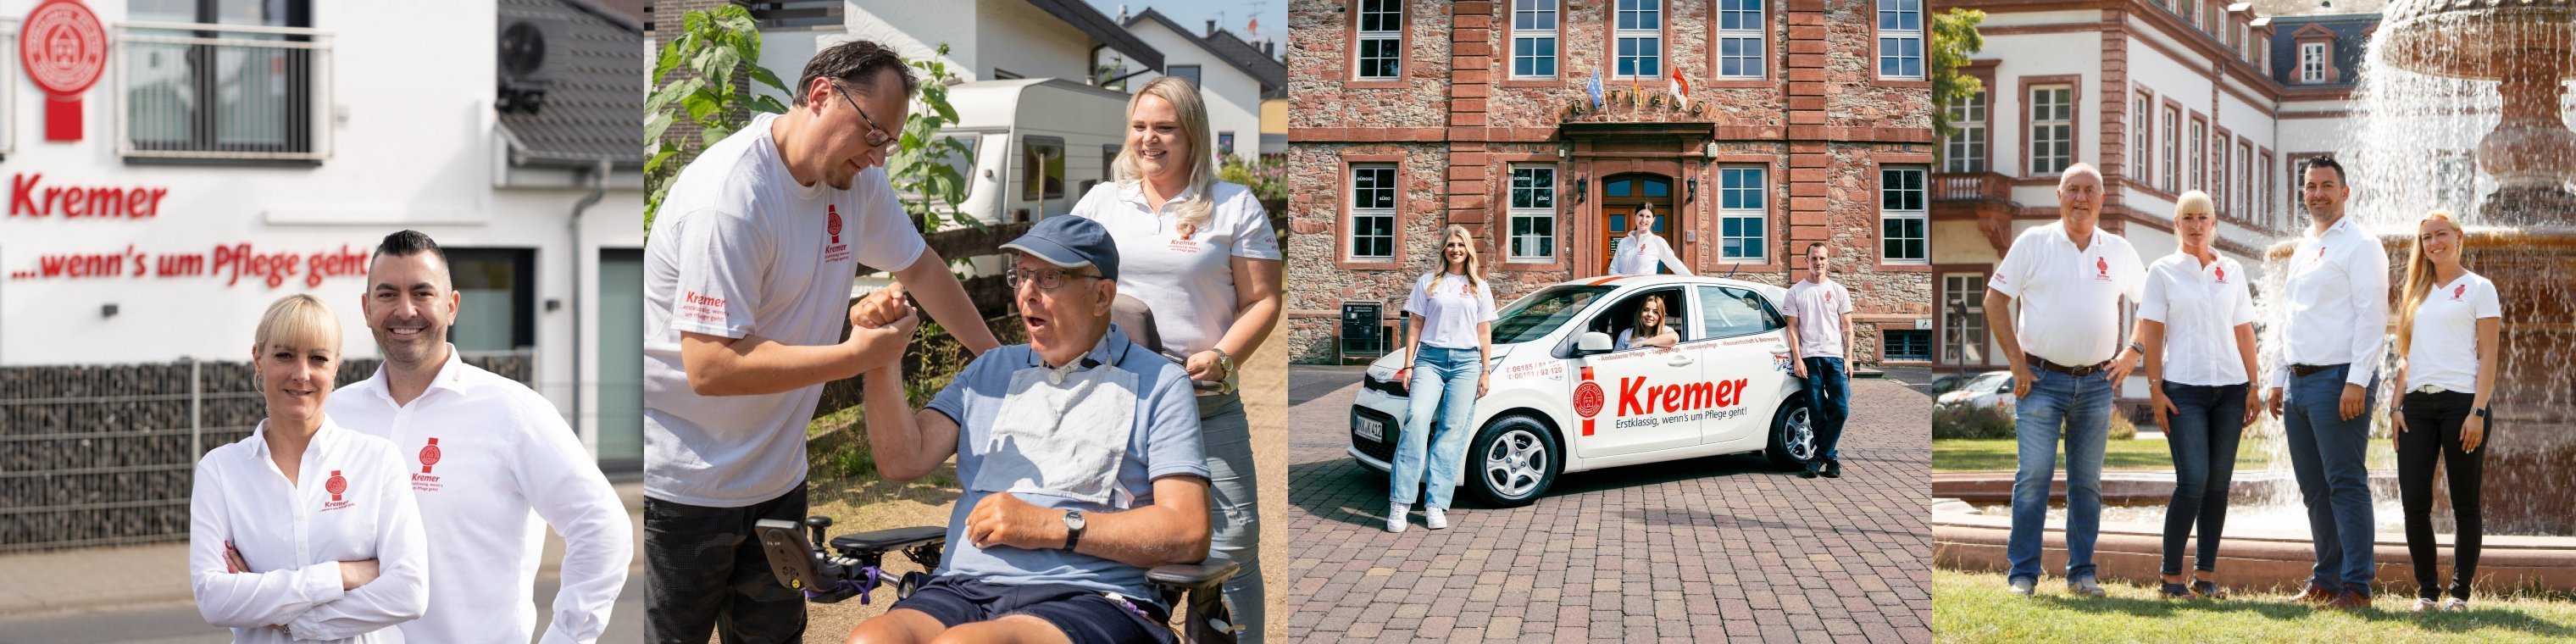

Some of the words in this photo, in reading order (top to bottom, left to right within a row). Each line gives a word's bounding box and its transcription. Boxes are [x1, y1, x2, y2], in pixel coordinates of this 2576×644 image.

[8, 173, 167, 219] Kremer
[824, 244, 847, 254] Kremer
[11, 244, 147, 278] ...wenn's
[157, 253, 203, 278] um
[212, 242, 300, 288] Pflege
[306, 244, 369, 289] geht
[686, 291, 726, 308] Kremer
[1601, 352, 1629, 361] Ambulante
[1652, 347, 1681, 355] Tagespflege
[1512, 364, 1534, 373] 06185
[1540, 368, 1549, 376] 92
[1551, 366, 1563, 375] 120
[1617, 375, 1748, 417] Kremer
[1616, 416, 1660, 429] Erstklassig,
[1662, 413, 1689, 425] wenn's
[1690, 413, 1703, 421] um
[1705, 408, 1727, 420] Pflege
[1728, 407, 1748, 419] geht!
[1371, 423, 1382, 438] 412
[411, 473, 441, 482] Kremer
